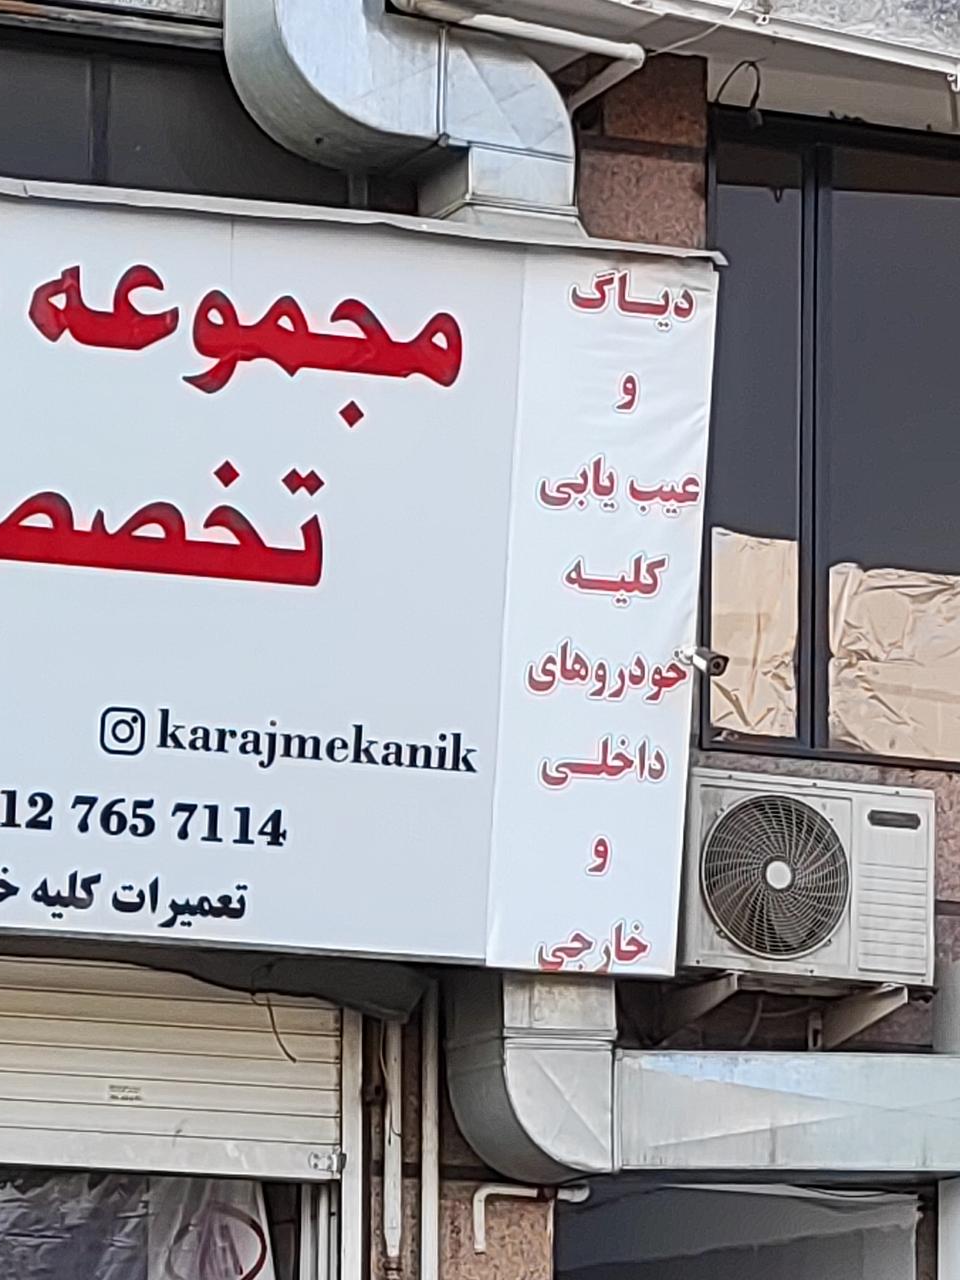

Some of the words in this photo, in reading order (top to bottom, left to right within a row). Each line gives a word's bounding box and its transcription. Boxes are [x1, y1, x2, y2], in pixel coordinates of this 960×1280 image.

[569, 271, 694, 328] دیاگ
[27, 262, 466, 430] مجموعه
[615, 375, 637, 410] و
[539, 456, 615, 507] یابی
[629, 476, 701, 514] عیب
[564, 554, 666, 605] کلیه
[156, 708, 478, 773] karajmekanik
[541, 737, 666, 786] داخلی
[71, 795, 156, 838] 765
[171, 803, 287, 847] 7114
[587, 838, 609, 873] و
[31, 870, 102, 919] کلیه
[110, 876, 248, 928] تعمیرات
[537, 922, 648, 974] خارجی
